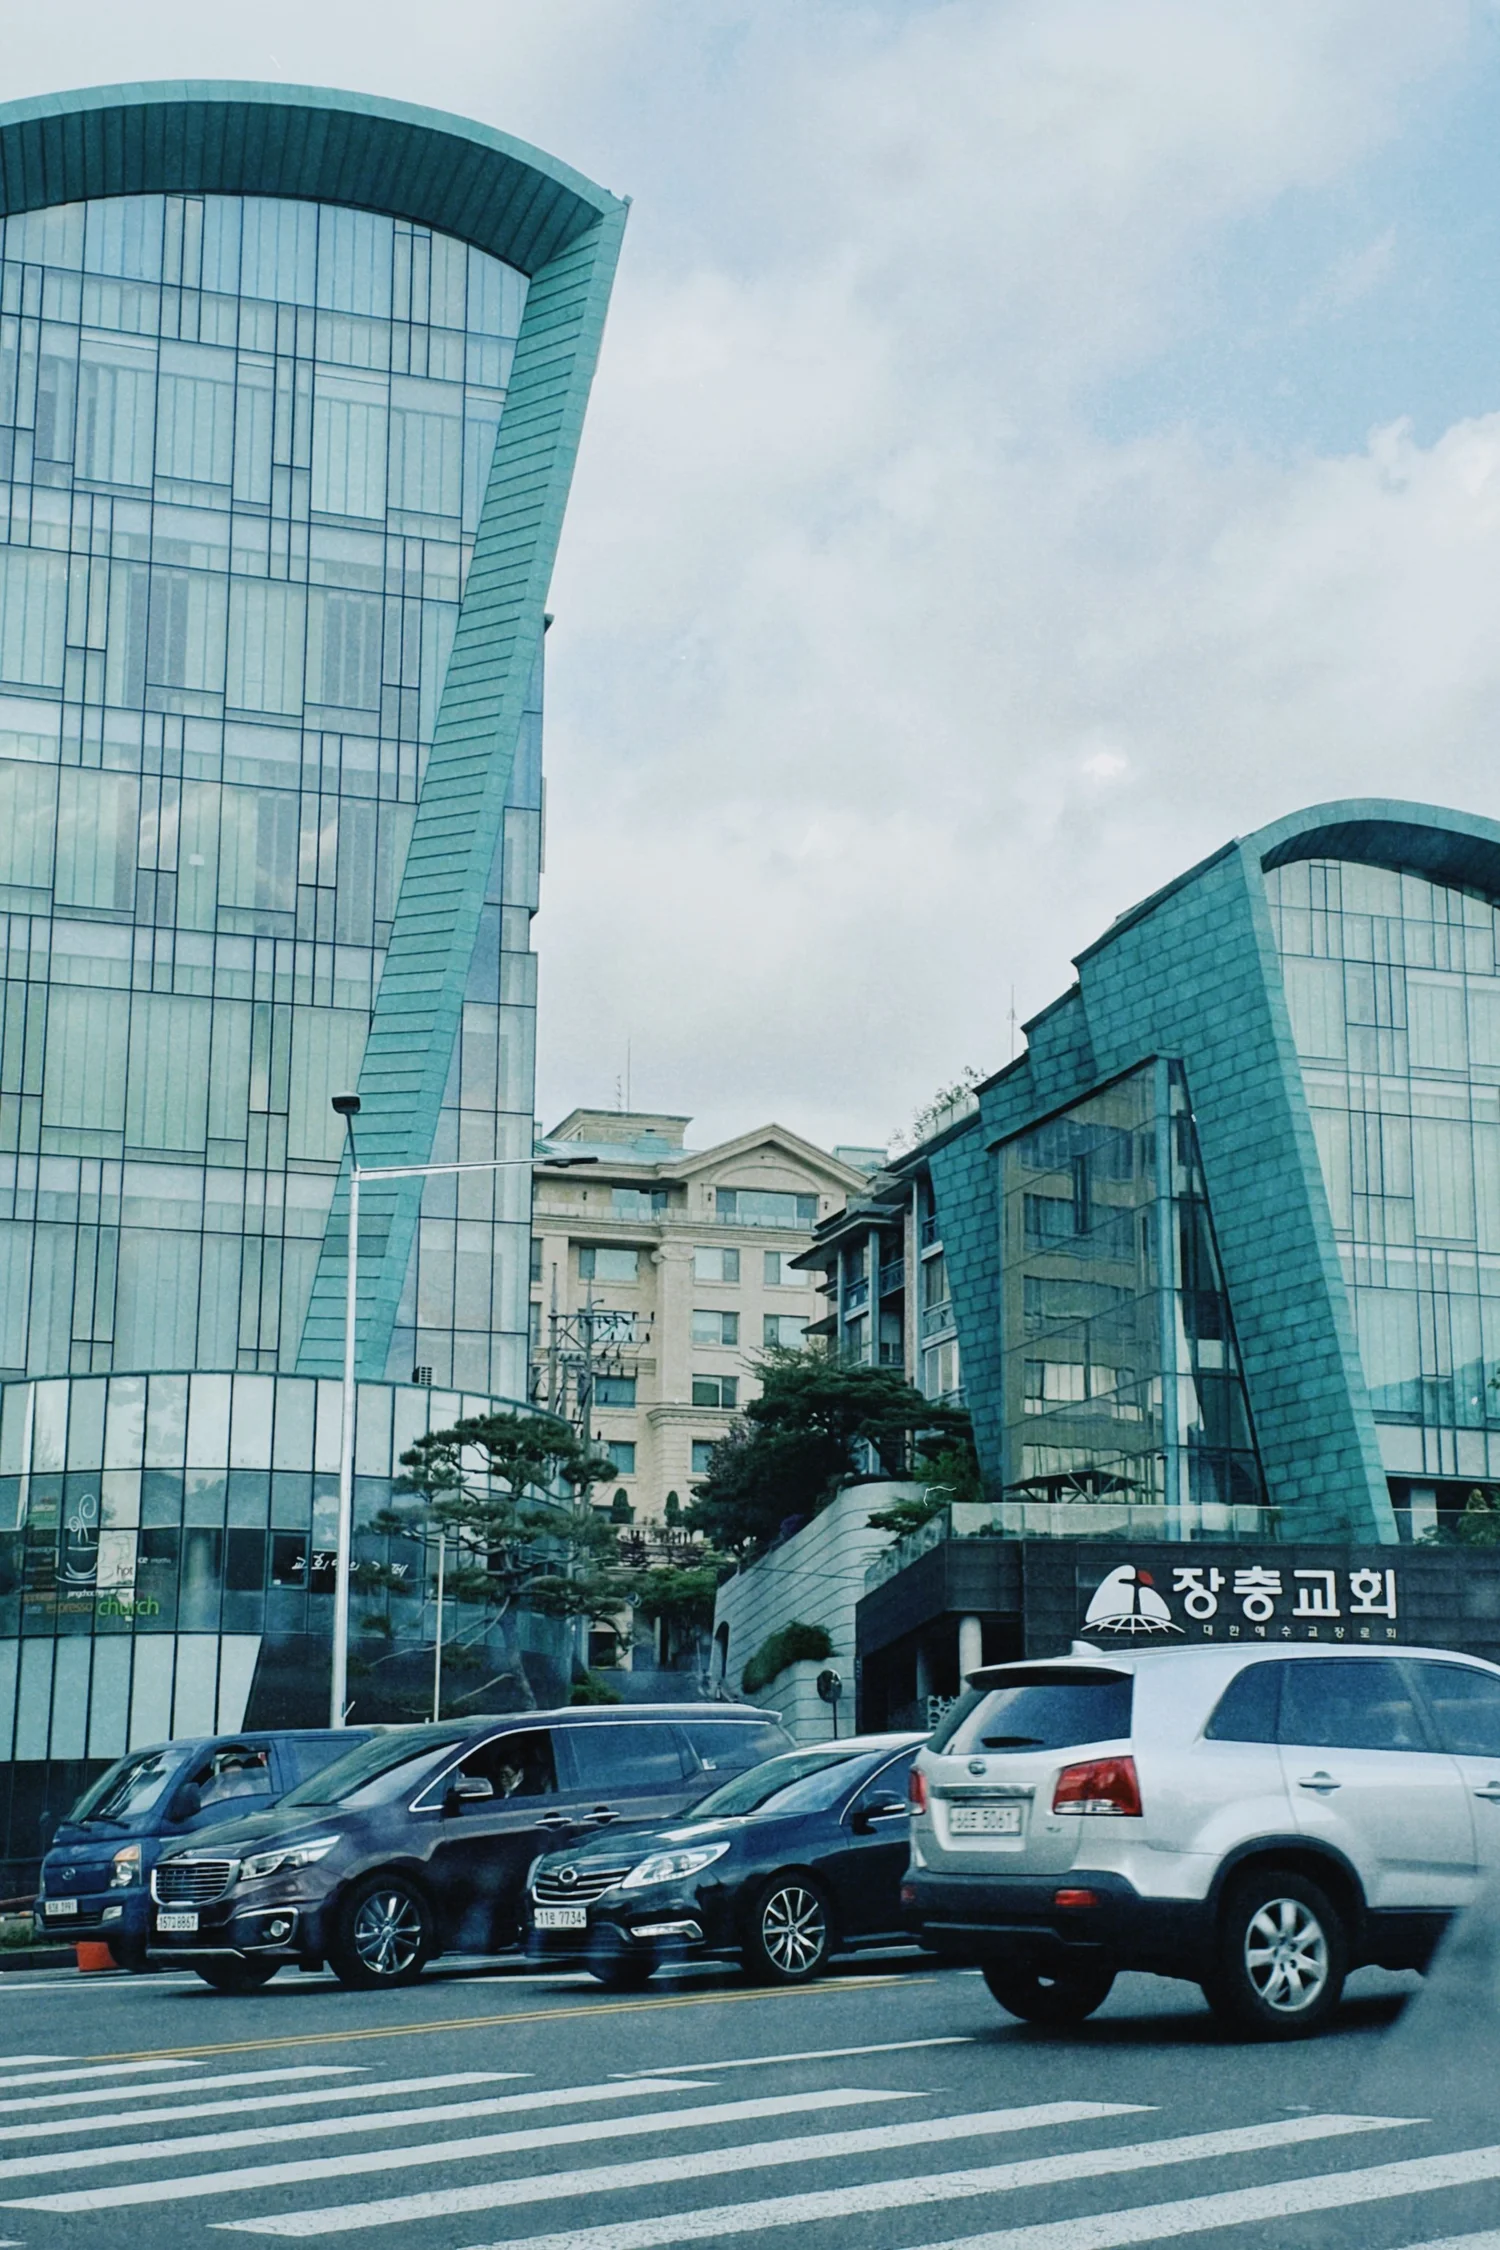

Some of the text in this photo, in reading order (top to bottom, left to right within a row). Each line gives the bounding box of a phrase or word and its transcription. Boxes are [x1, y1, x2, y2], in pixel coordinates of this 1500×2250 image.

[1172, 1565, 1398, 1622] 장충교회
[98, 1596, 159, 1615] church
[1203, 1624, 1397, 1639] 대한예수교장로회
